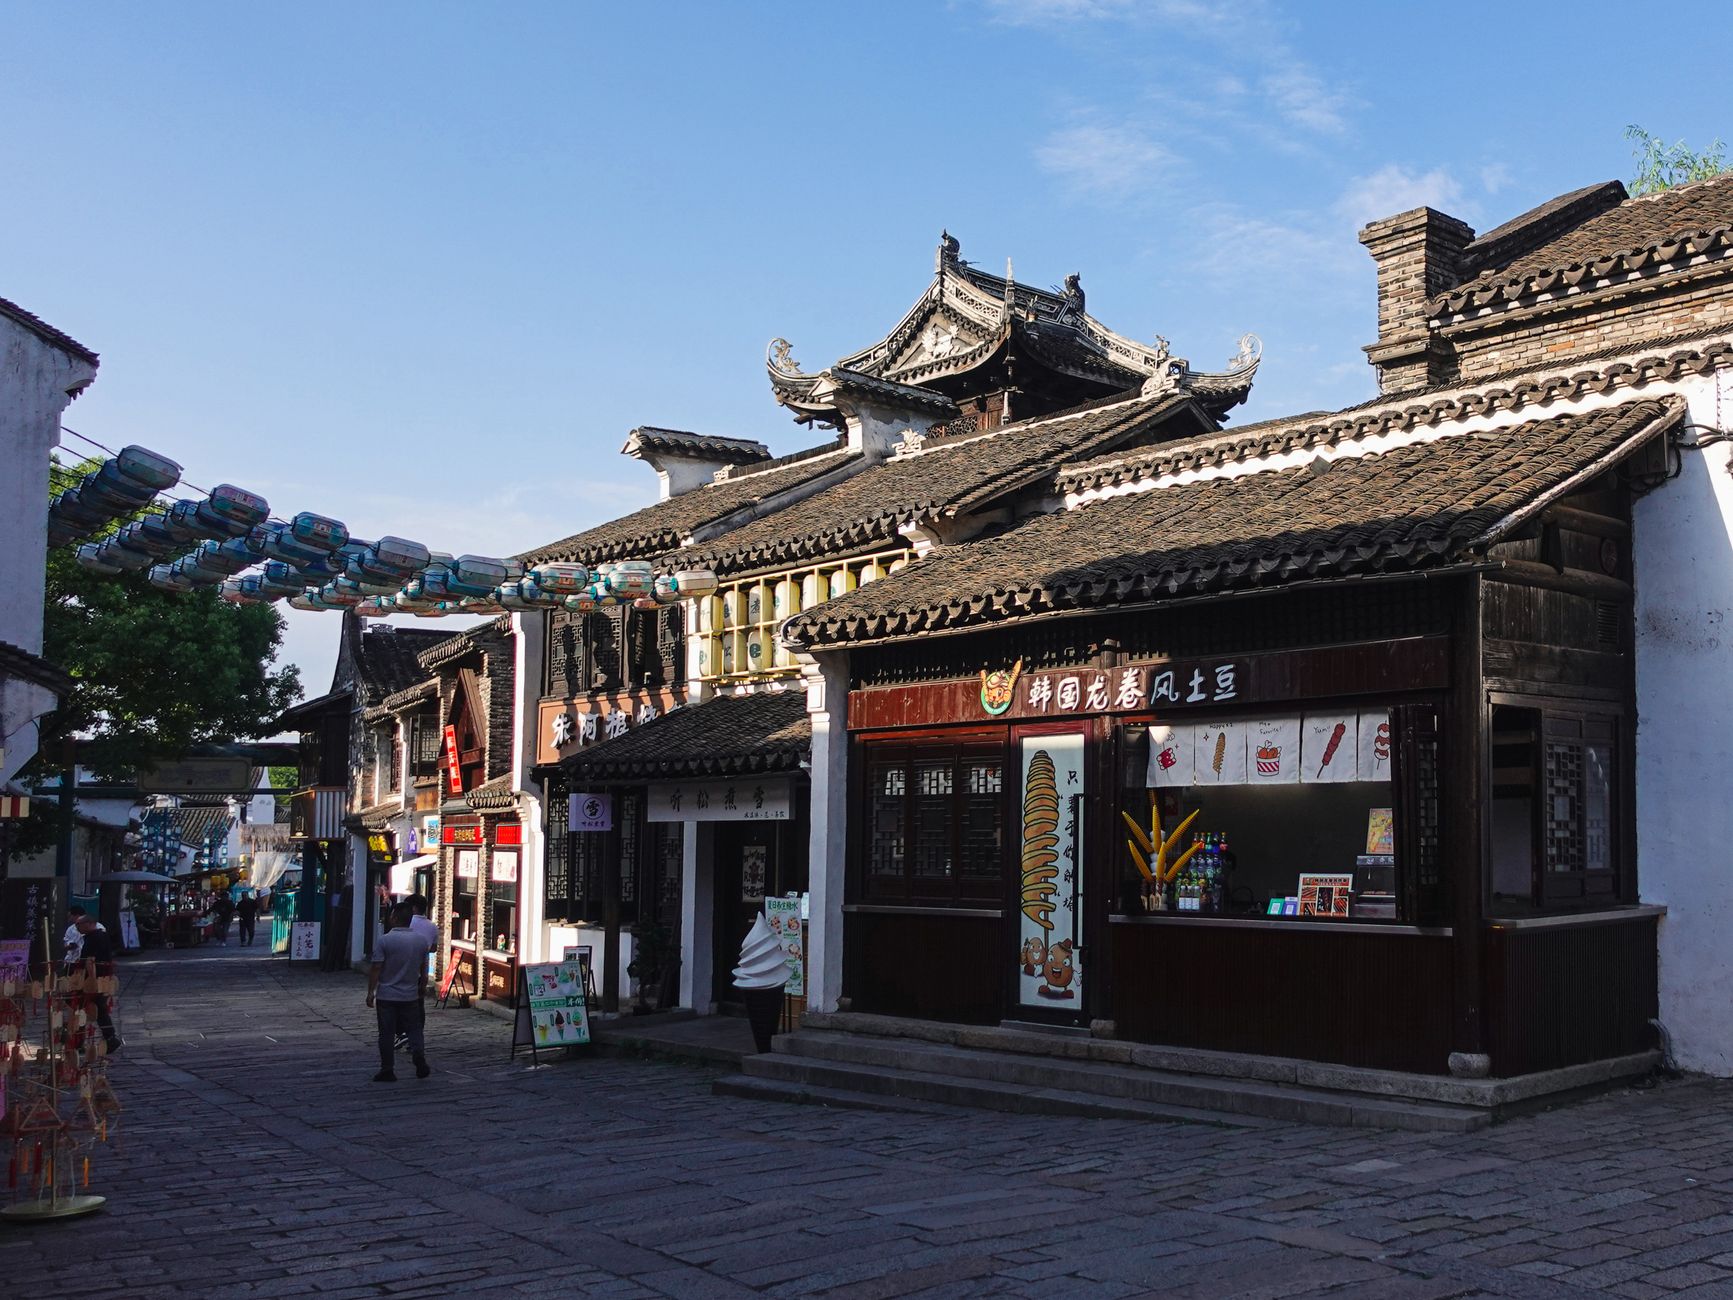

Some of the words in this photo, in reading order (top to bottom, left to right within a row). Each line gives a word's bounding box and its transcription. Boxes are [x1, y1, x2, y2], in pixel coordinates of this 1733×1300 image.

[1028, 663, 1239, 713] 韩国龙卷风土豆
[586, 800, 601, 817] 雪
